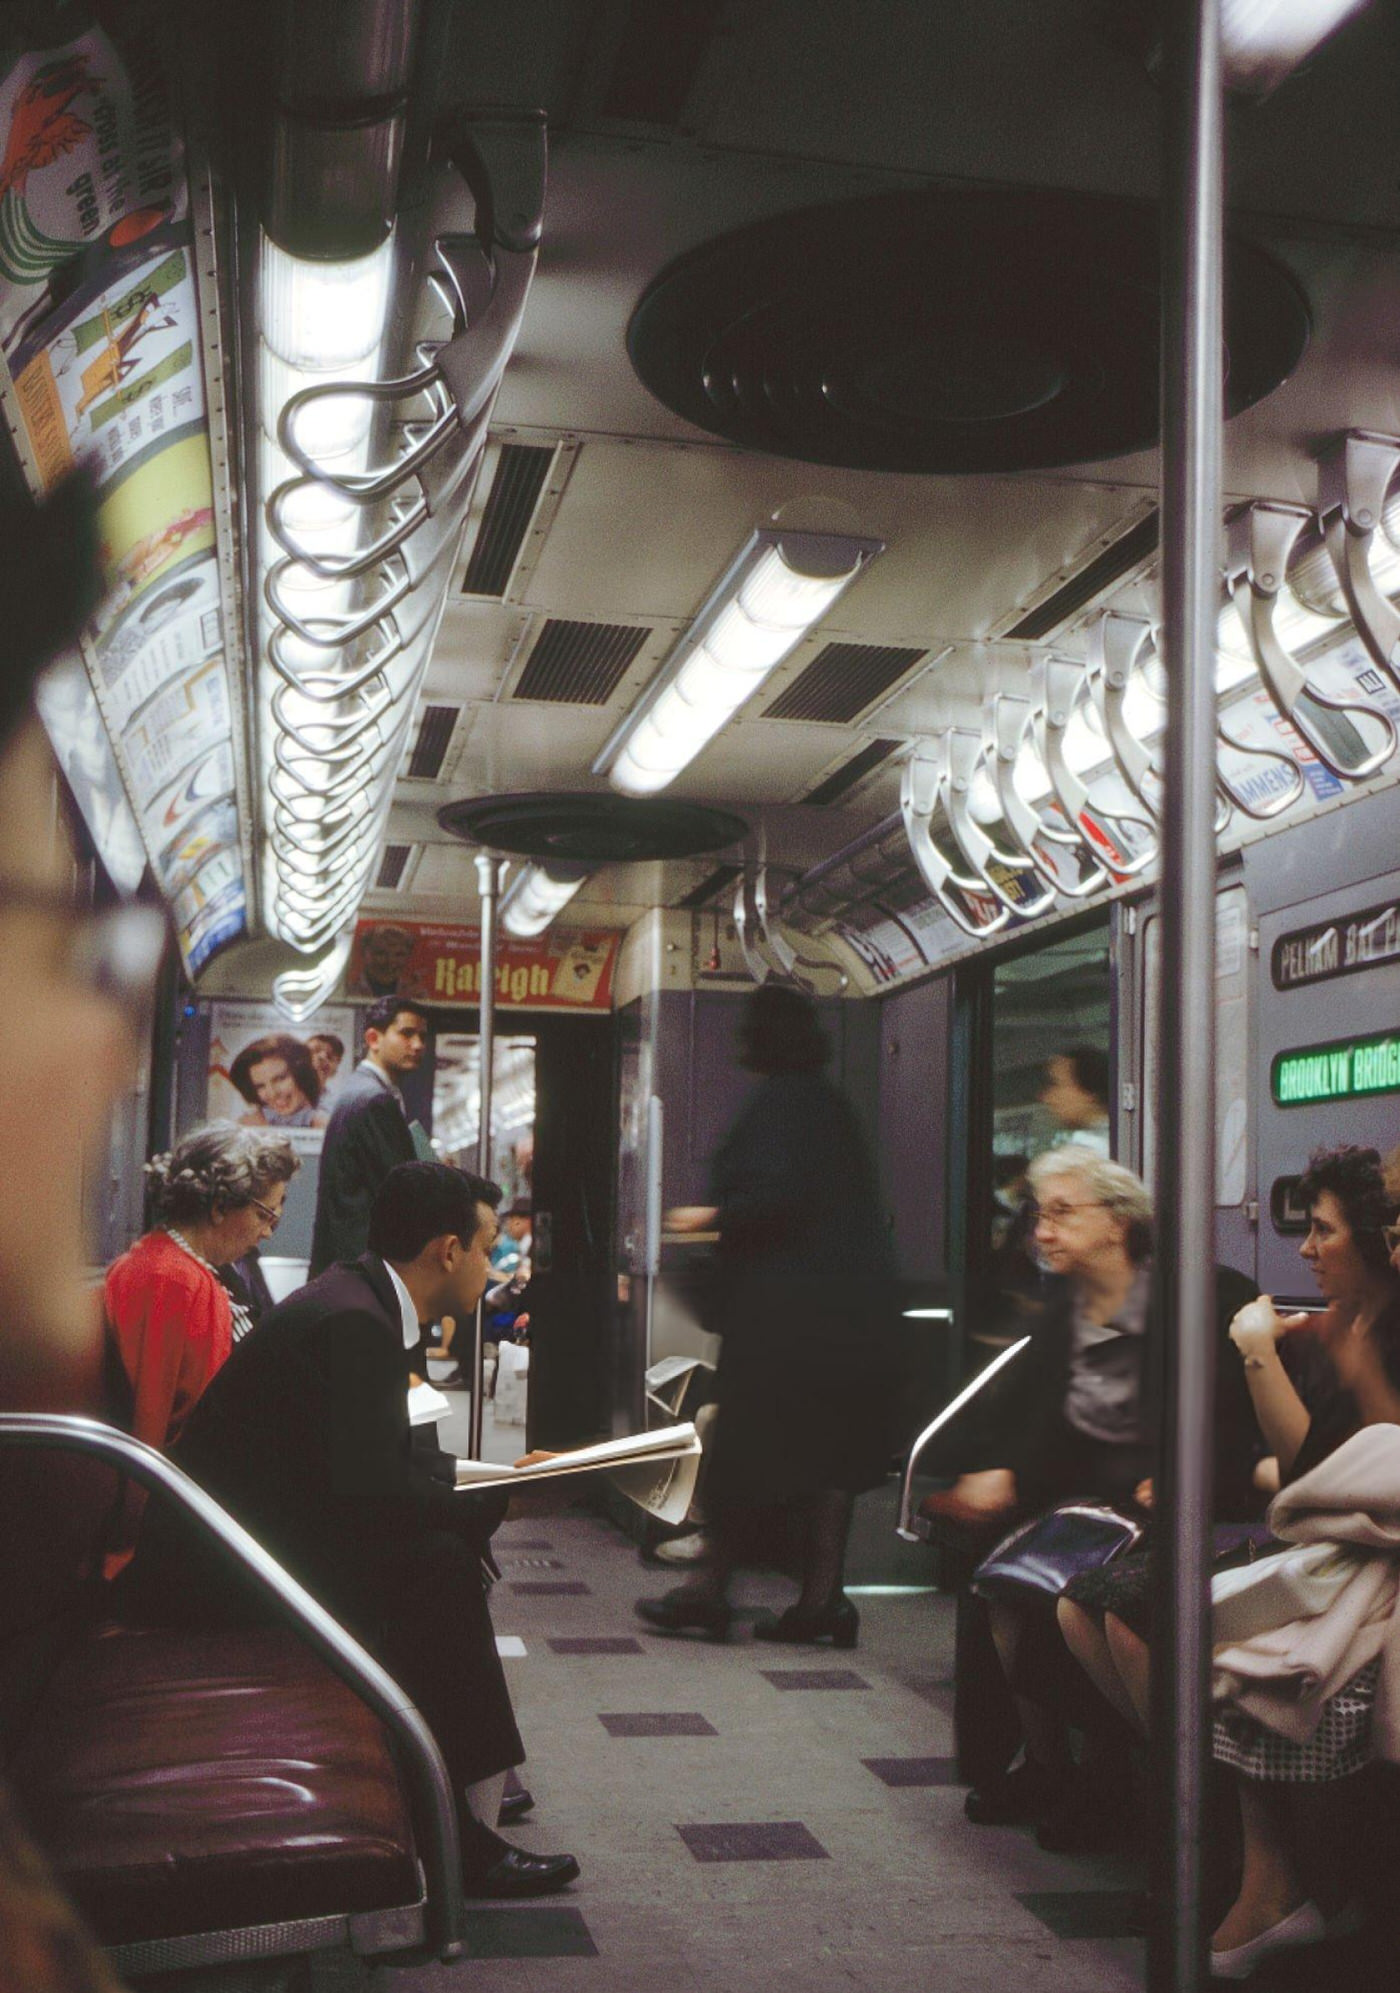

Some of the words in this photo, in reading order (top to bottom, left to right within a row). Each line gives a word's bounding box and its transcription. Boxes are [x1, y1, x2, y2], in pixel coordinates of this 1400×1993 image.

[66, 172, 100, 236] green
[435, 957, 549, 1002] Raligh
[1281, 926, 1339, 982] PELHAM
[1281, 1050, 1349, 1101] BROOKLYN
[1353, 1041, 1400, 1089] BRIDG
